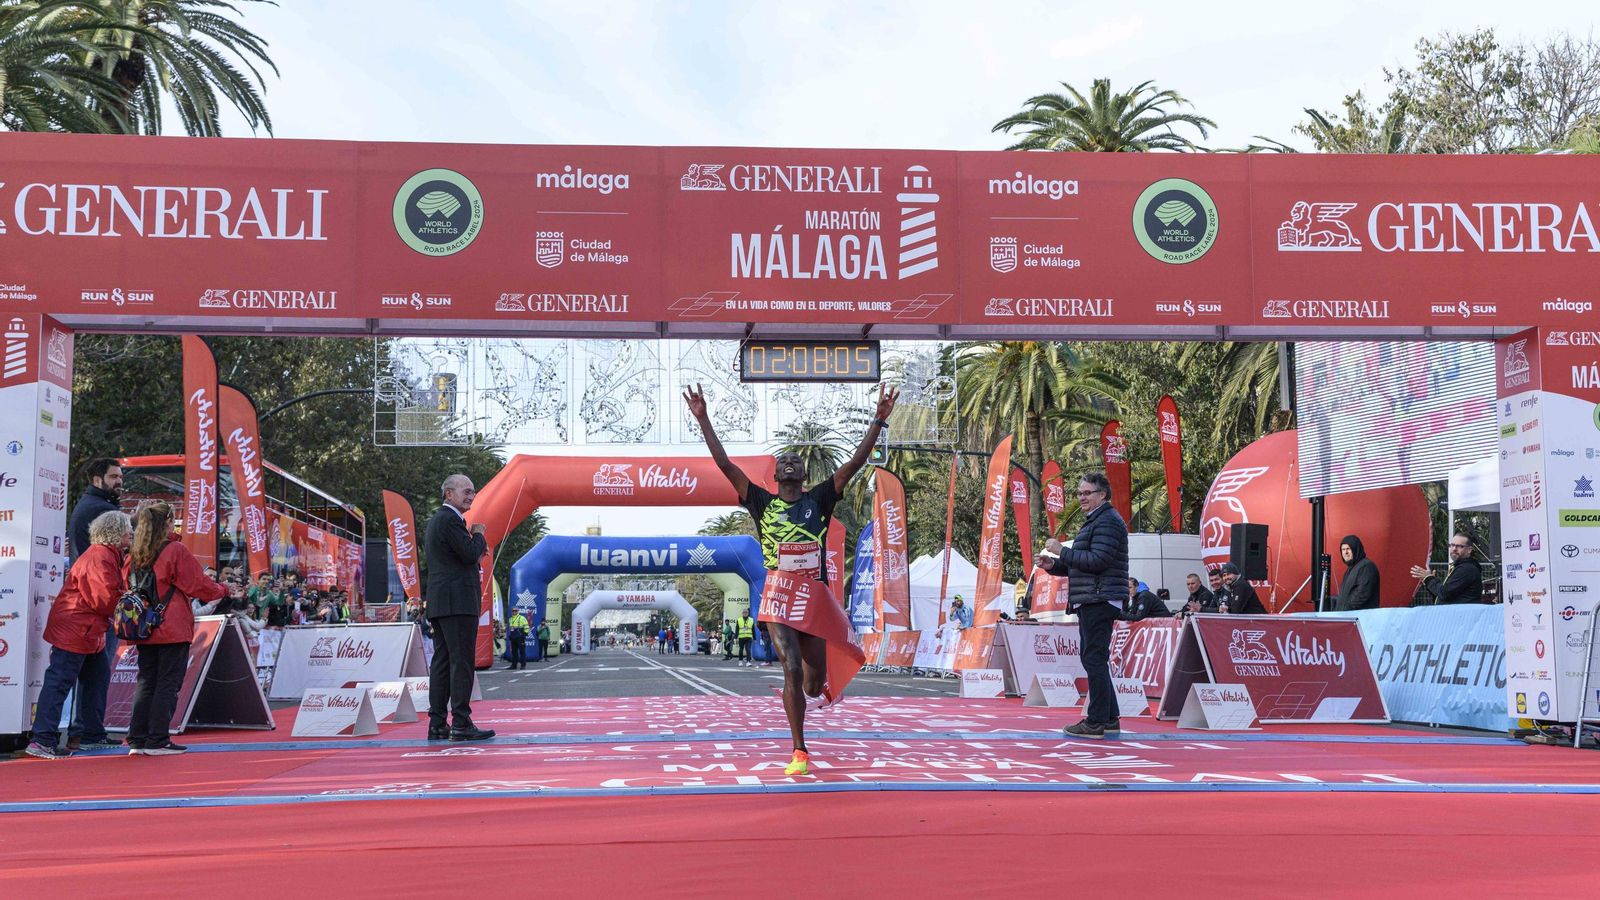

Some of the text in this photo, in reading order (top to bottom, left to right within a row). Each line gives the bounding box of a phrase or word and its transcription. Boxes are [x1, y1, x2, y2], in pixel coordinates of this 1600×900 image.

[729, 164, 882, 193] GENERALI
[14, 182, 329, 241] GENERALI
[805, 208, 881, 230] MARATÓN
[418, 227, 458, 235] ATHLETICS
[423, 199, 481, 253] ROAD RACE LABEL 2024
[424, 220, 452, 228] WORLD
[1163, 208, 1216, 261] ROAD RACE LABEL 2024
[570, 239, 611, 250] Ciudad
[730, 224, 888, 281] MÁLAGA
[1023, 244, 1063, 255] Ciudad
[570, 251, 629, 265] de Málaga
[1023, 257, 1081, 270] de Málaga
[10, 291, 38, 301] Málaga
[81, 287, 154, 306] RUN & SUN
[232, 289, 337, 310] GENERALI
[381, 292, 452, 310] RUN & SUN
[527, 293, 629, 313] GENERALI
[725, 299, 736, 310] EN
[738, 300, 749, 310] LA
[750, 300, 768, 310] VIDA
[770, 300, 794, 310] COMO
[796, 301, 807, 311] EN
[809, 301, 817, 311] EL
[858, 301, 892, 312] VALORES
[1015, 298, 1114, 317] GENERALI
[1156, 299, 1222, 317] RUN & SUN
[1293, 300, 1390, 318] GENERALI
[1431, 300, 1497, 318] RUN & SUN
[750, 346, 870, 374] 02:08:05
[1521, 394, 1539, 409] renfe
[638, 464, 698, 495] Vitality
[593, 487, 634, 496] GENERALI
[986, 474, 1006, 530] Vitality
[580, 543, 678, 567] luanvi
[625, 594, 656, 603] YAMAHA
[336, 636, 375, 666] Vitality
[1275, 630, 1345, 677] Vitality
[1234, 664, 1281, 677] GENERALI
[1116, 683, 1143, 696] Vitality
[1219, 689, 1250, 706] Vitality
[327, 694, 360, 711] Vitality
